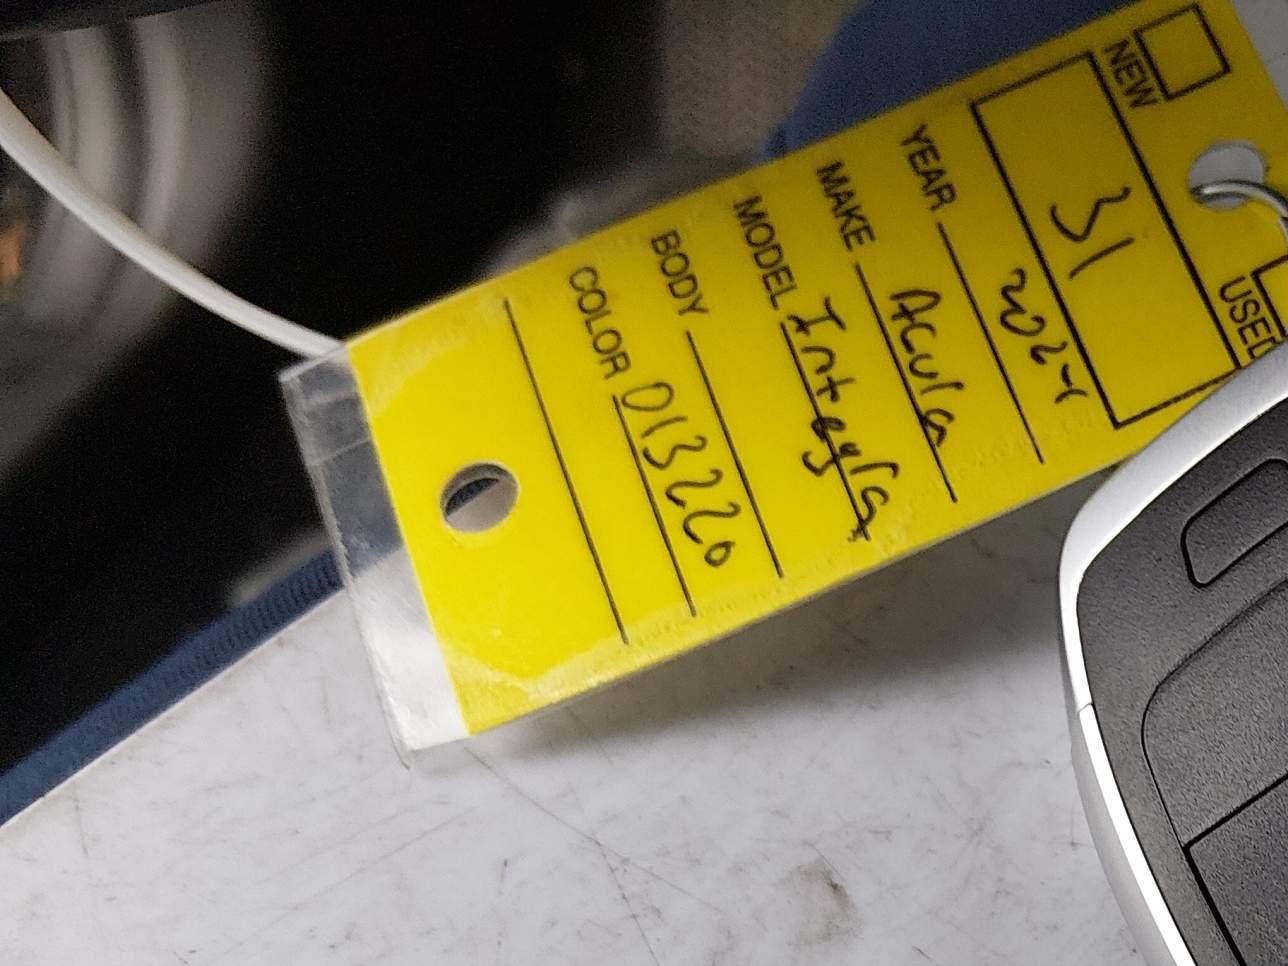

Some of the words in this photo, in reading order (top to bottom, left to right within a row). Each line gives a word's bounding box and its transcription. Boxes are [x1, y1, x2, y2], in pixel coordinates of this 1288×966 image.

[1104, 39, 1159, 108] NEW
[815, 159, 875, 252] MAKE
[901, 123, 957, 212] YEAR
[650, 229, 709, 317] BODY
[733, 195, 798, 310] MODEL
[1050, 187, 1131, 279] 31
[568, 266, 631, 380] COLOR
[889, 288, 964, 447] Acura
